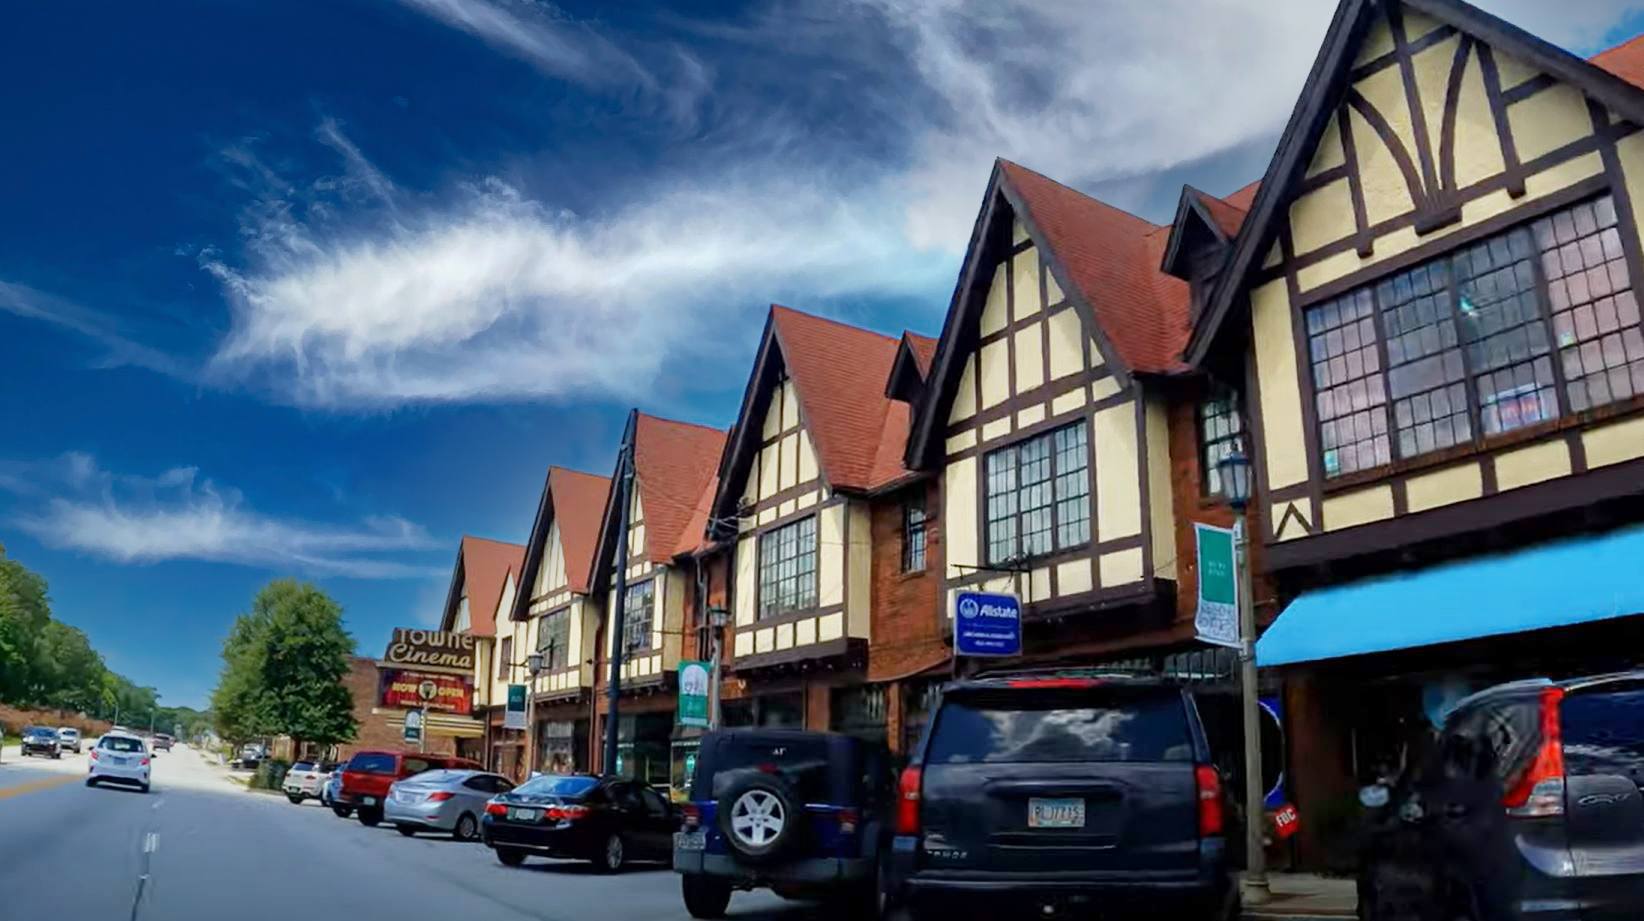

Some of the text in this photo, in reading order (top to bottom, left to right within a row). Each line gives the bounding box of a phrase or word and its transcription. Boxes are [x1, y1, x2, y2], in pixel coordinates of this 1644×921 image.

[980, 604, 1018, 618] Allstate
[389, 643, 472, 668] Cinema
[438, 687, 464, 697] OPEN
